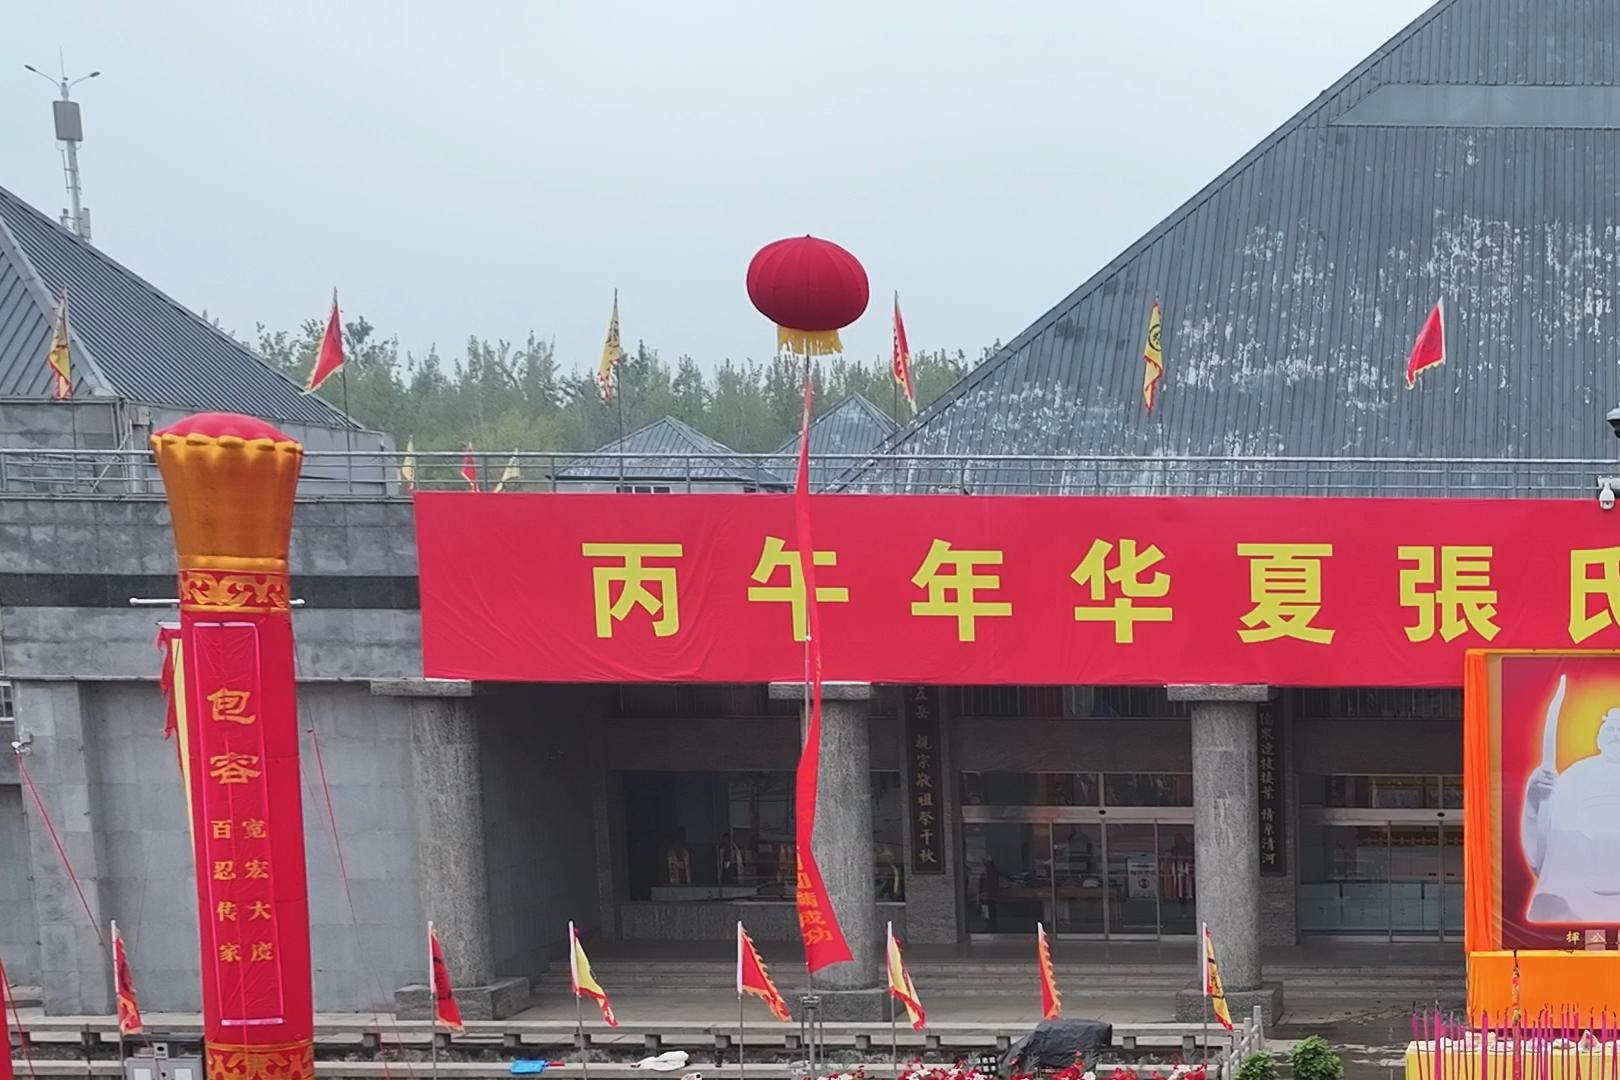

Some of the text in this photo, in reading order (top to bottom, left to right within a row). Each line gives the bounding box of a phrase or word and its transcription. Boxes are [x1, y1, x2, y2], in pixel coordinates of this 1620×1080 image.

[206, 687, 262, 785] 包容
[210, 818, 242, 963] 百忍传家
[241, 818, 275, 962] 宽宏大度
